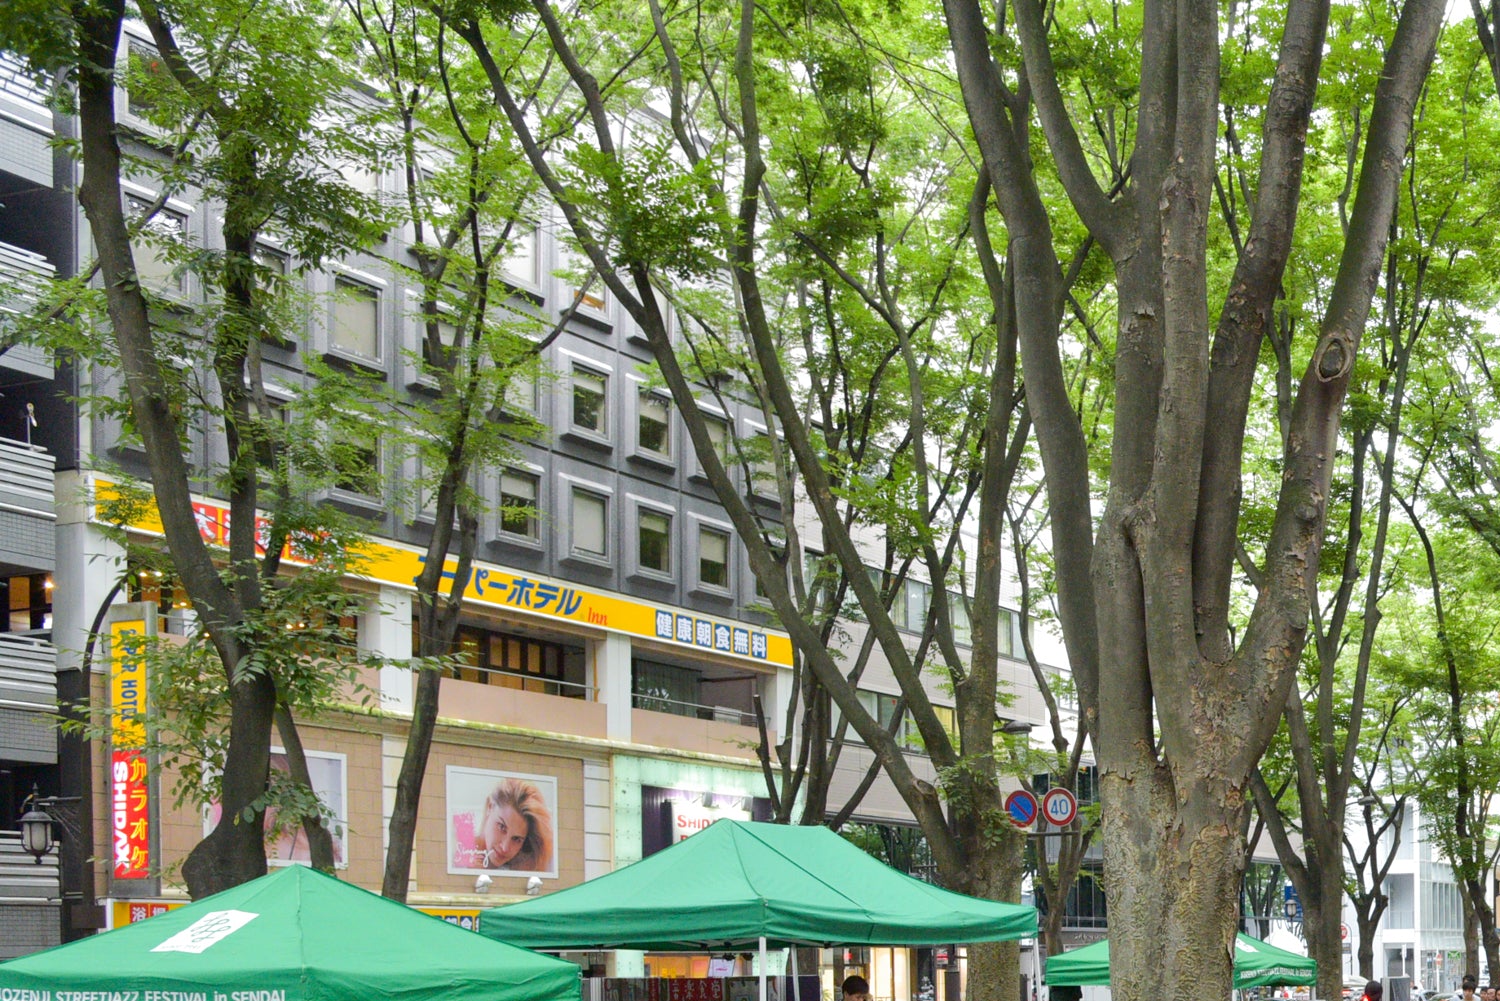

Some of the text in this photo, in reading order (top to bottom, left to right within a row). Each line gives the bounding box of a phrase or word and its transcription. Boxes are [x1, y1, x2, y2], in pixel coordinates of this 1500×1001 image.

[413, 556, 583, 615] ーパーホテル
[588, 607, 609, 626] Inn
[656, 611, 767, 658] 健康朝食無料
[114, 761, 130, 869] SHIDAX
[130, 758, 149, 869] カラオケ
[677, 814, 717, 830] SHID
[1051, 799, 1068, 815] 40
